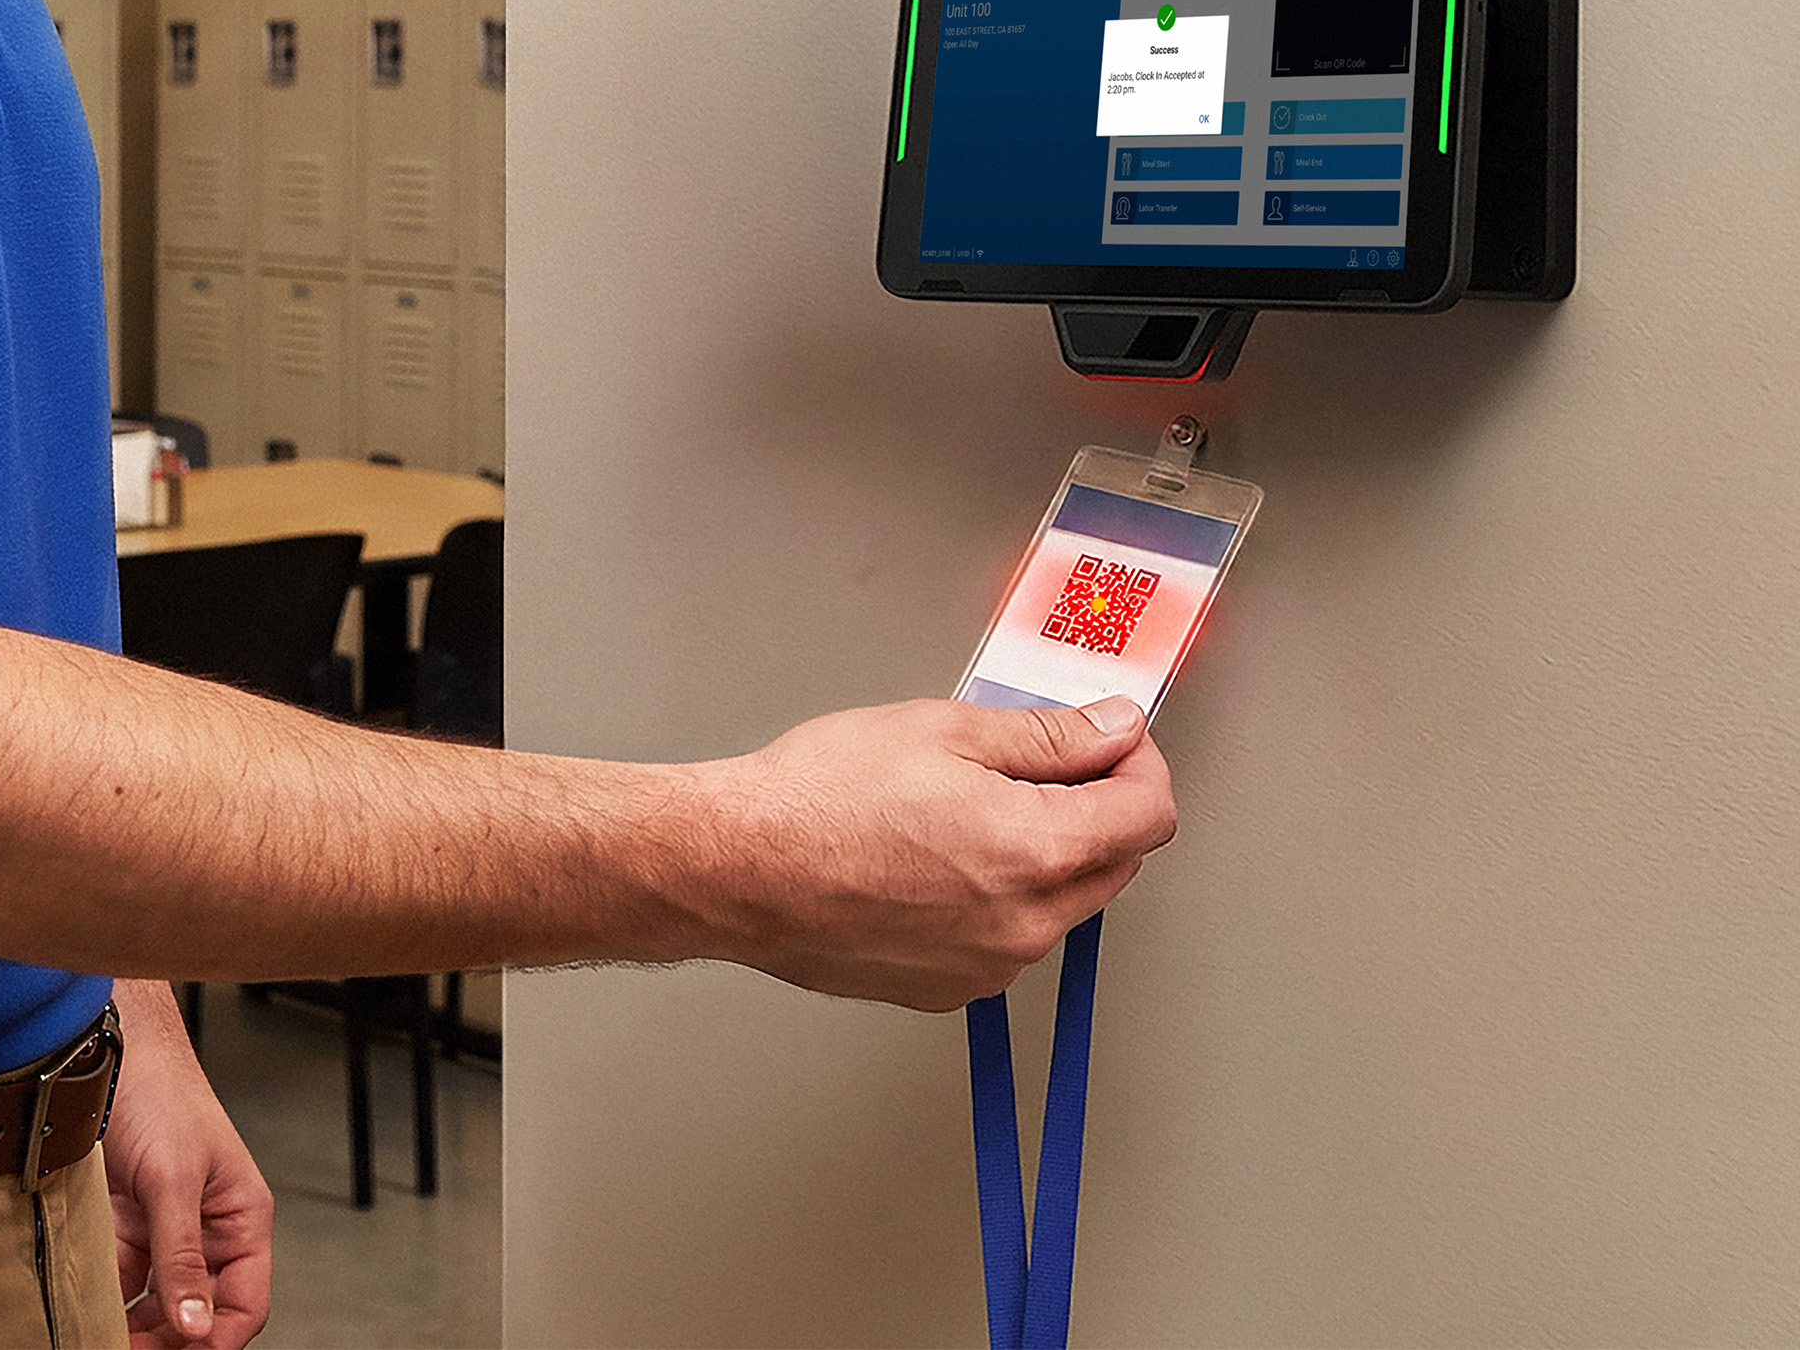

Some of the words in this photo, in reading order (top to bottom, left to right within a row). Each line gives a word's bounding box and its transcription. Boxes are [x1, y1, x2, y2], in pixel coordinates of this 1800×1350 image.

[946, 3, 968, 18] Unit
[971, 2, 991, 17] 100
[945, 27, 956, 36] 100
[956, 27, 972, 36] EAST
[972, 26, 997, 35] STREET,
[997, 26, 1006, 34] CA
[943, 41, 958, 50] Open
[959, 40, 967, 48] All
[967, 39, 979, 49] Day
[1149, 46, 1179, 55] Success
[1314, 59, 1332, 70] Scan
[1333, 58, 1346, 70] QR
[1347, 58, 1366, 68] Code
[1107, 72, 1134, 82] Jacobs,
[1135, 71, 1155, 81] Clock
[1156, 71, 1162, 80] In
[1163, 70, 1197, 81] Accepted
[1197, 70, 1205, 79] at
[1107, 85, 1122, 94] 2:20
[1123, 87, 1136, 95] pm.
[1199, 114, 1210, 124] OK
[1298, 113, 1315, 122] Clock
[1316, 113, 1327, 121] Out
[1142, 160, 1156, 168] Meal
[1156, 160, 1171, 168] Start
[1296, 158, 1310, 167] Meal
[1311, 158, 1323, 166] End
[1138, 203, 1155, 212] Labor
[1156, 203, 1178, 212] Transfer
[1292, 204, 1327, 213] Self-Service
